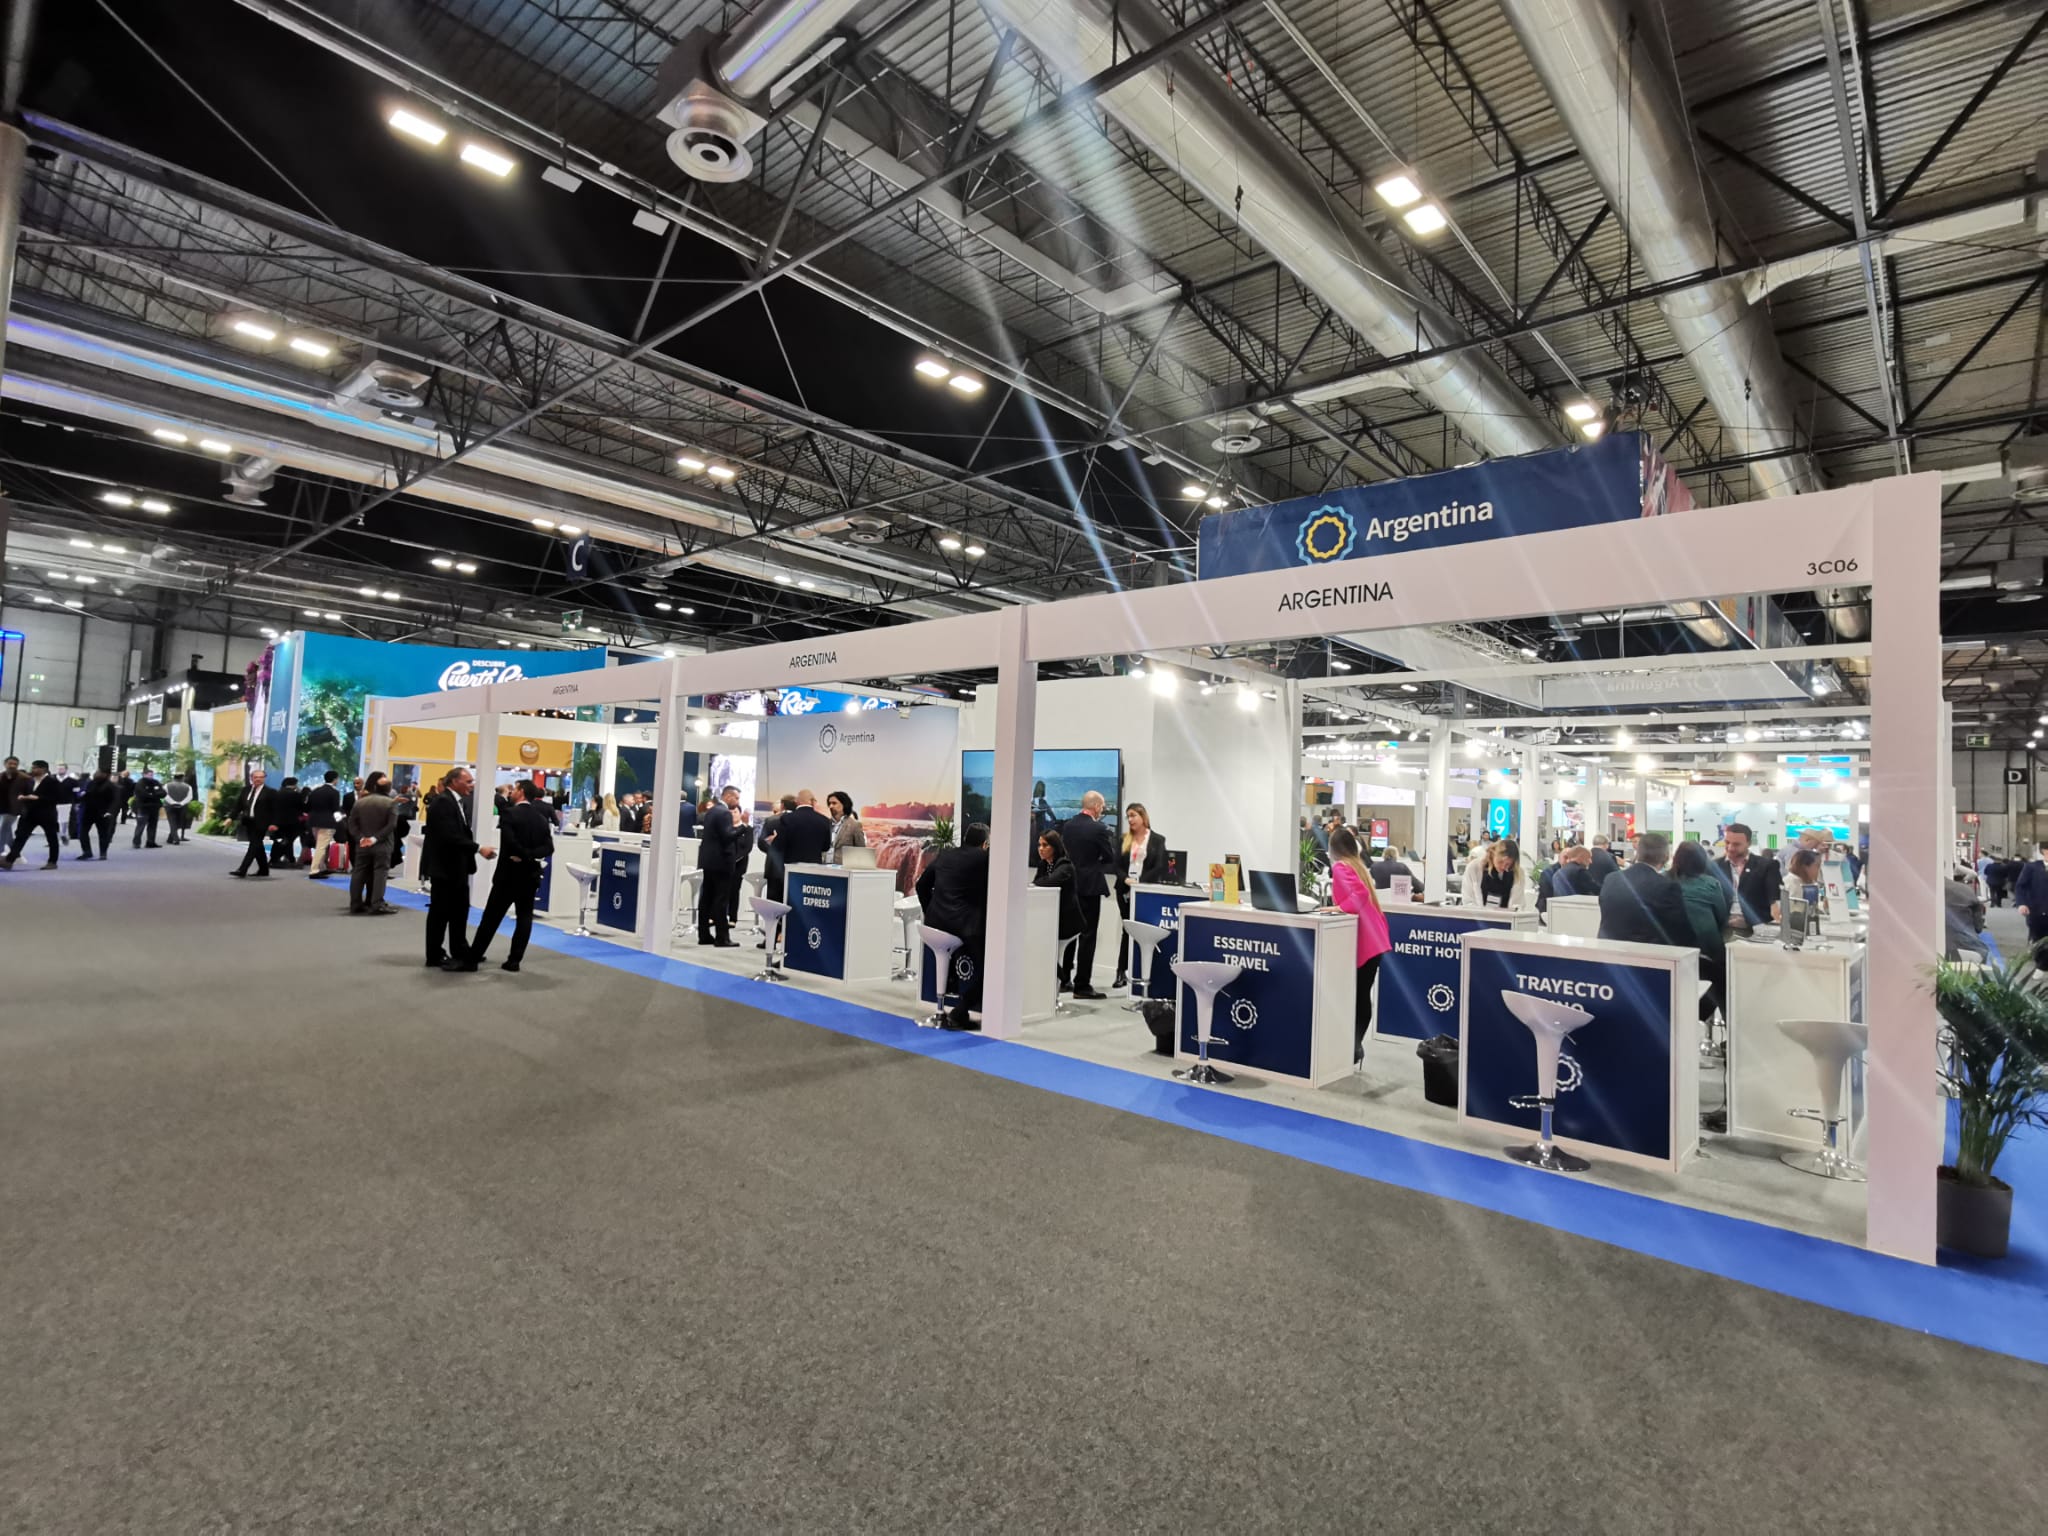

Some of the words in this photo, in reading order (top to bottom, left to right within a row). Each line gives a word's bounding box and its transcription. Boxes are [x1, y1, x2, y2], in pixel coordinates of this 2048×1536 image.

[1366, 501, 1494, 542] Argentina
[572, 540, 584, 572] C
[1806, 558, 1858, 576] 3C06
[1278, 582, 1394, 612] ARGENTINA
[789, 651, 837, 669] ARGENTINA
[840, 731, 875, 746] Argentina
[2008, 770, 2022, 783] D
[802, 885, 832, 897] ROTATIVO
[803, 896, 830, 909] EXPRESS
[1162, 906, 1173, 917] EL
[1160, 919, 1179, 931] ALM
[1213, 935, 1281, 956] ESSENTIAL
[1394, 942, 1433, 957] MERIT
[1435, 946, 1461, 960] HOT
[1222, 953, 1270, 972] TRAVEL
[1516, 973, 1614, 1001] TRAYECTO
